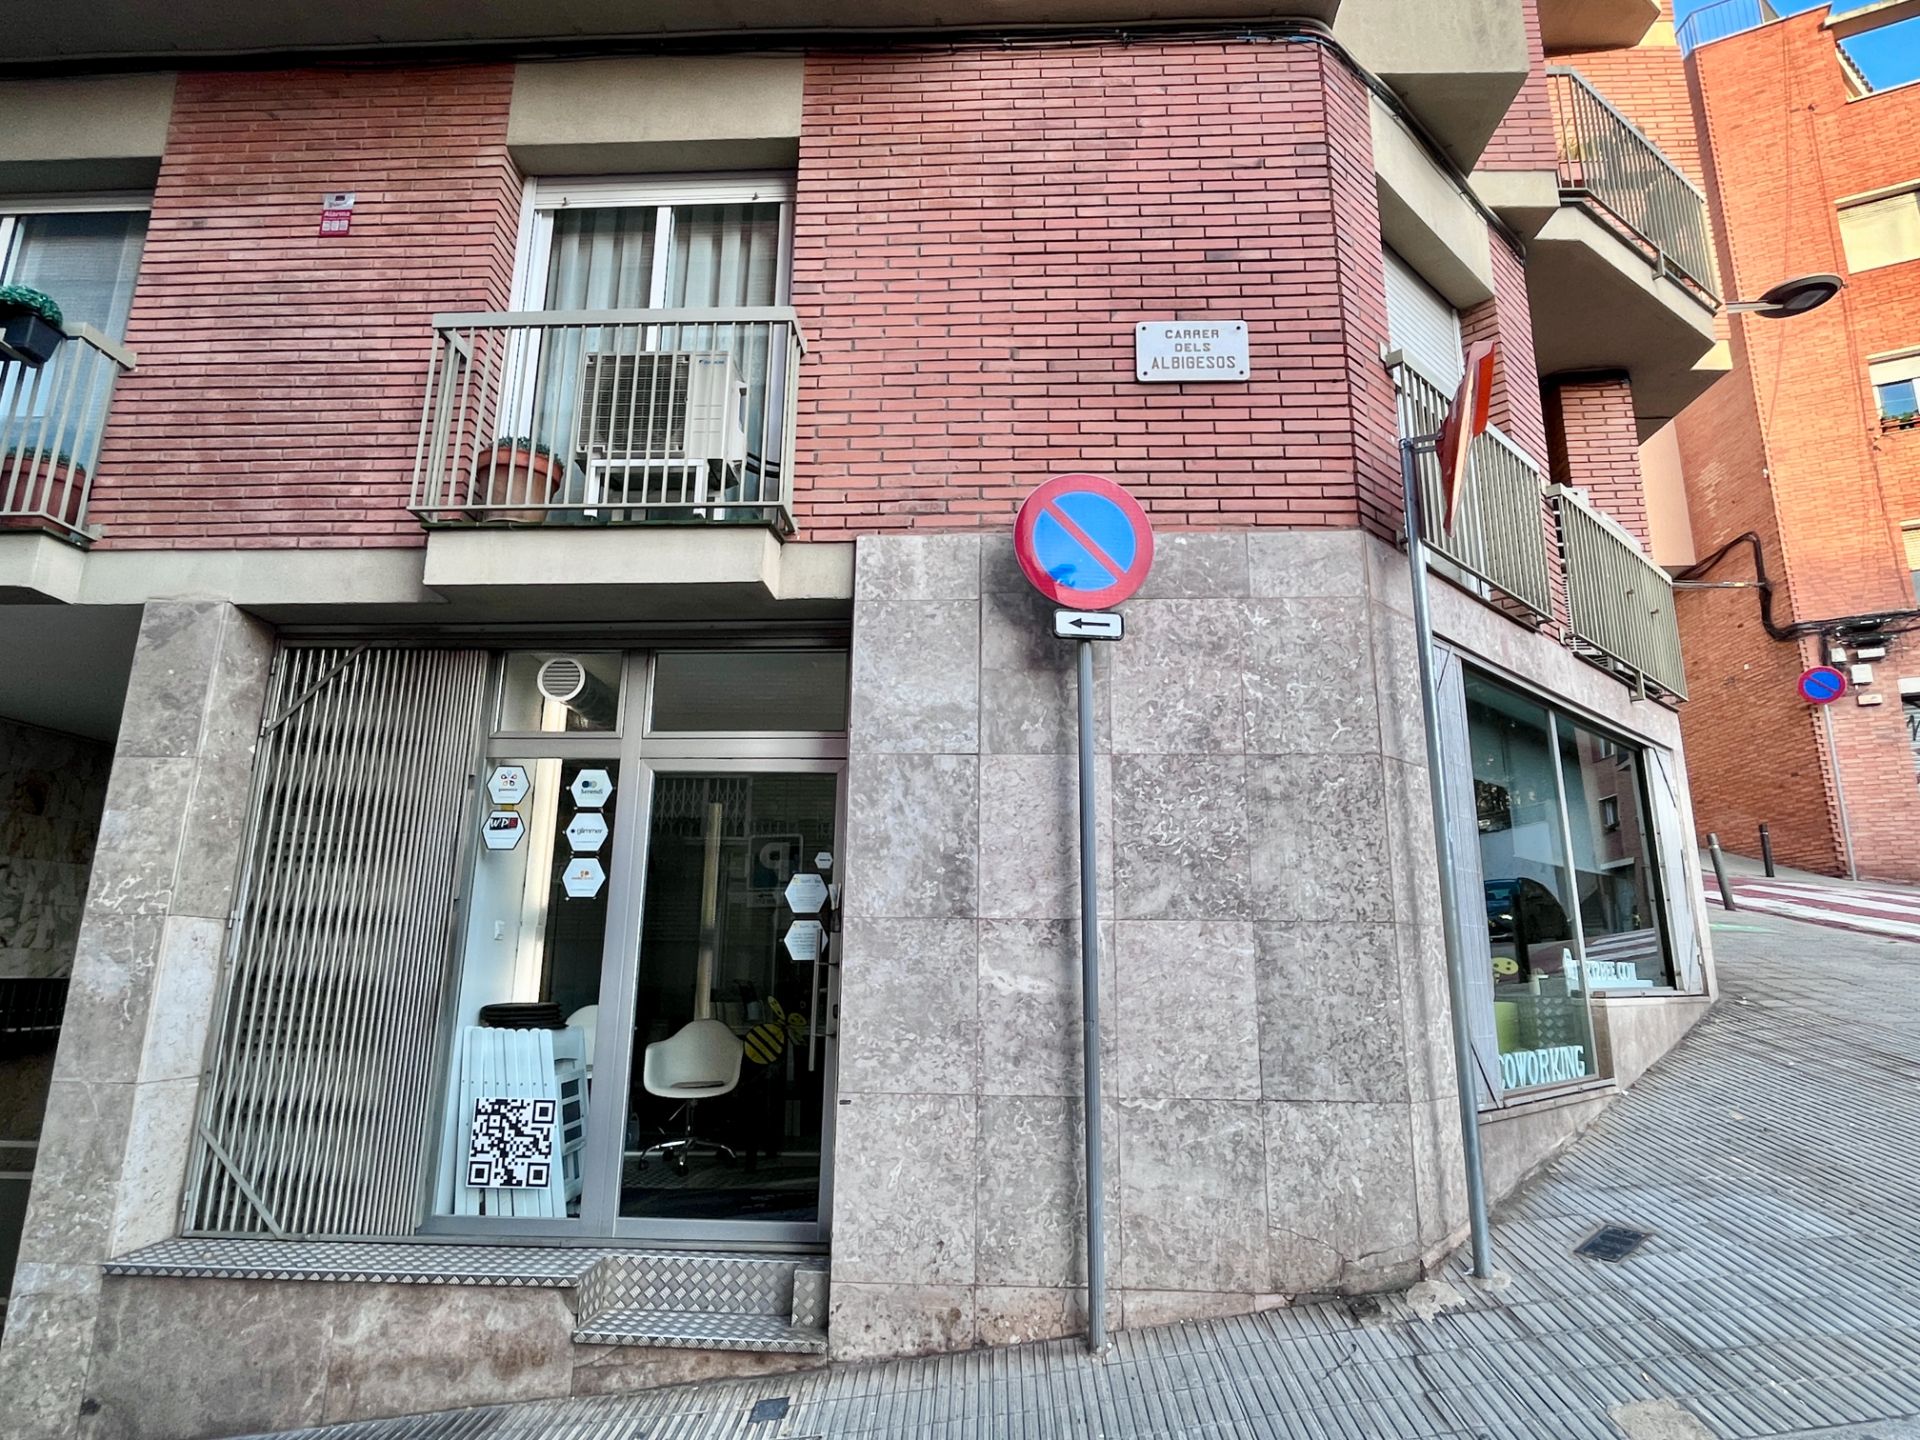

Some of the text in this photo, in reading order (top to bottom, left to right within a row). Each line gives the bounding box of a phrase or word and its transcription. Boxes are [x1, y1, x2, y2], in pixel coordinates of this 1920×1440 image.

[1165, 329, 1220, 339] CARRER
[1174, 343, 1211, 353] DELS
[1151, 355, 1236, 370] ALBIGESOS
